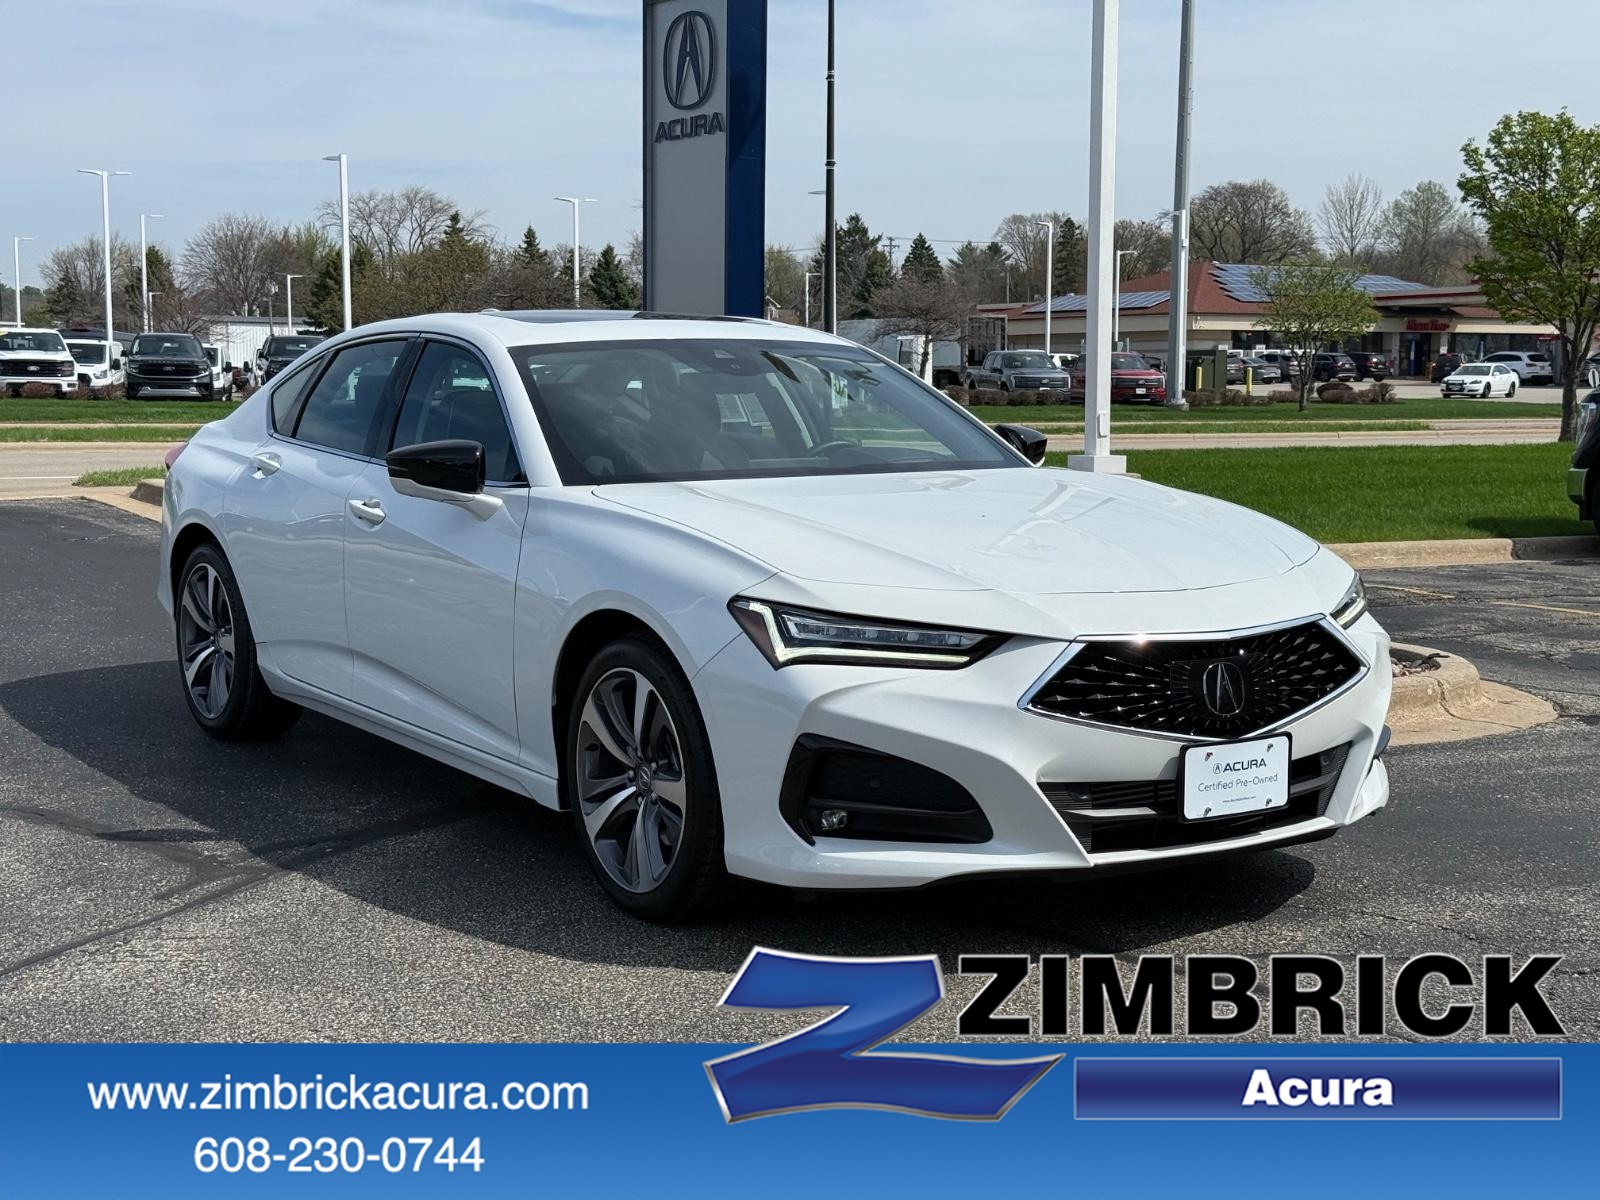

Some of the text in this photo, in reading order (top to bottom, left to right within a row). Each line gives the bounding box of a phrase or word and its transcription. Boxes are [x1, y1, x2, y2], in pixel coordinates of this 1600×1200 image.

[654, 112, 724, 143] ACURA
[1222, 758, 1267, 773] ACURA
[1197, 773, 1278, 792] Certified Pre-Owned
